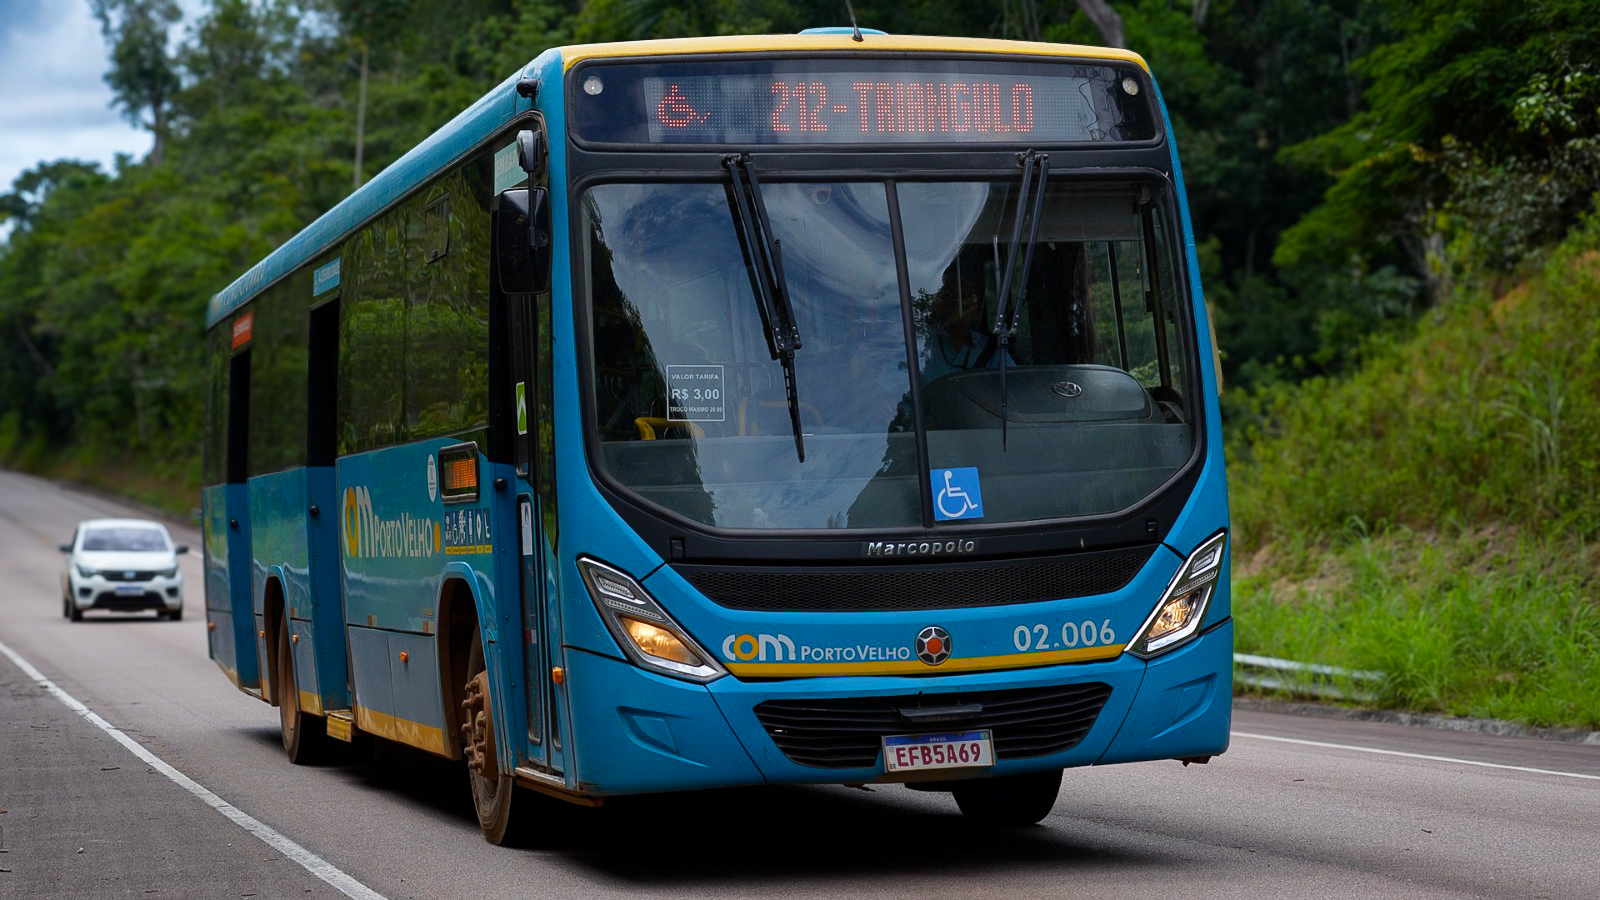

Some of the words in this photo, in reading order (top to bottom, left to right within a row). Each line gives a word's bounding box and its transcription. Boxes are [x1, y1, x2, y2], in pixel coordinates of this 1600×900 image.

[771, 82, 1034, 132] 212-TRIANGULO
[671, 388, 689, 401] R$
[693, 388, 720, 401] 3,00
[867, 539, 975, 556] Marcopolo
[1013, 618, 1115, 652] 02.006
[895, 743, 981, 767] EFB5A69
